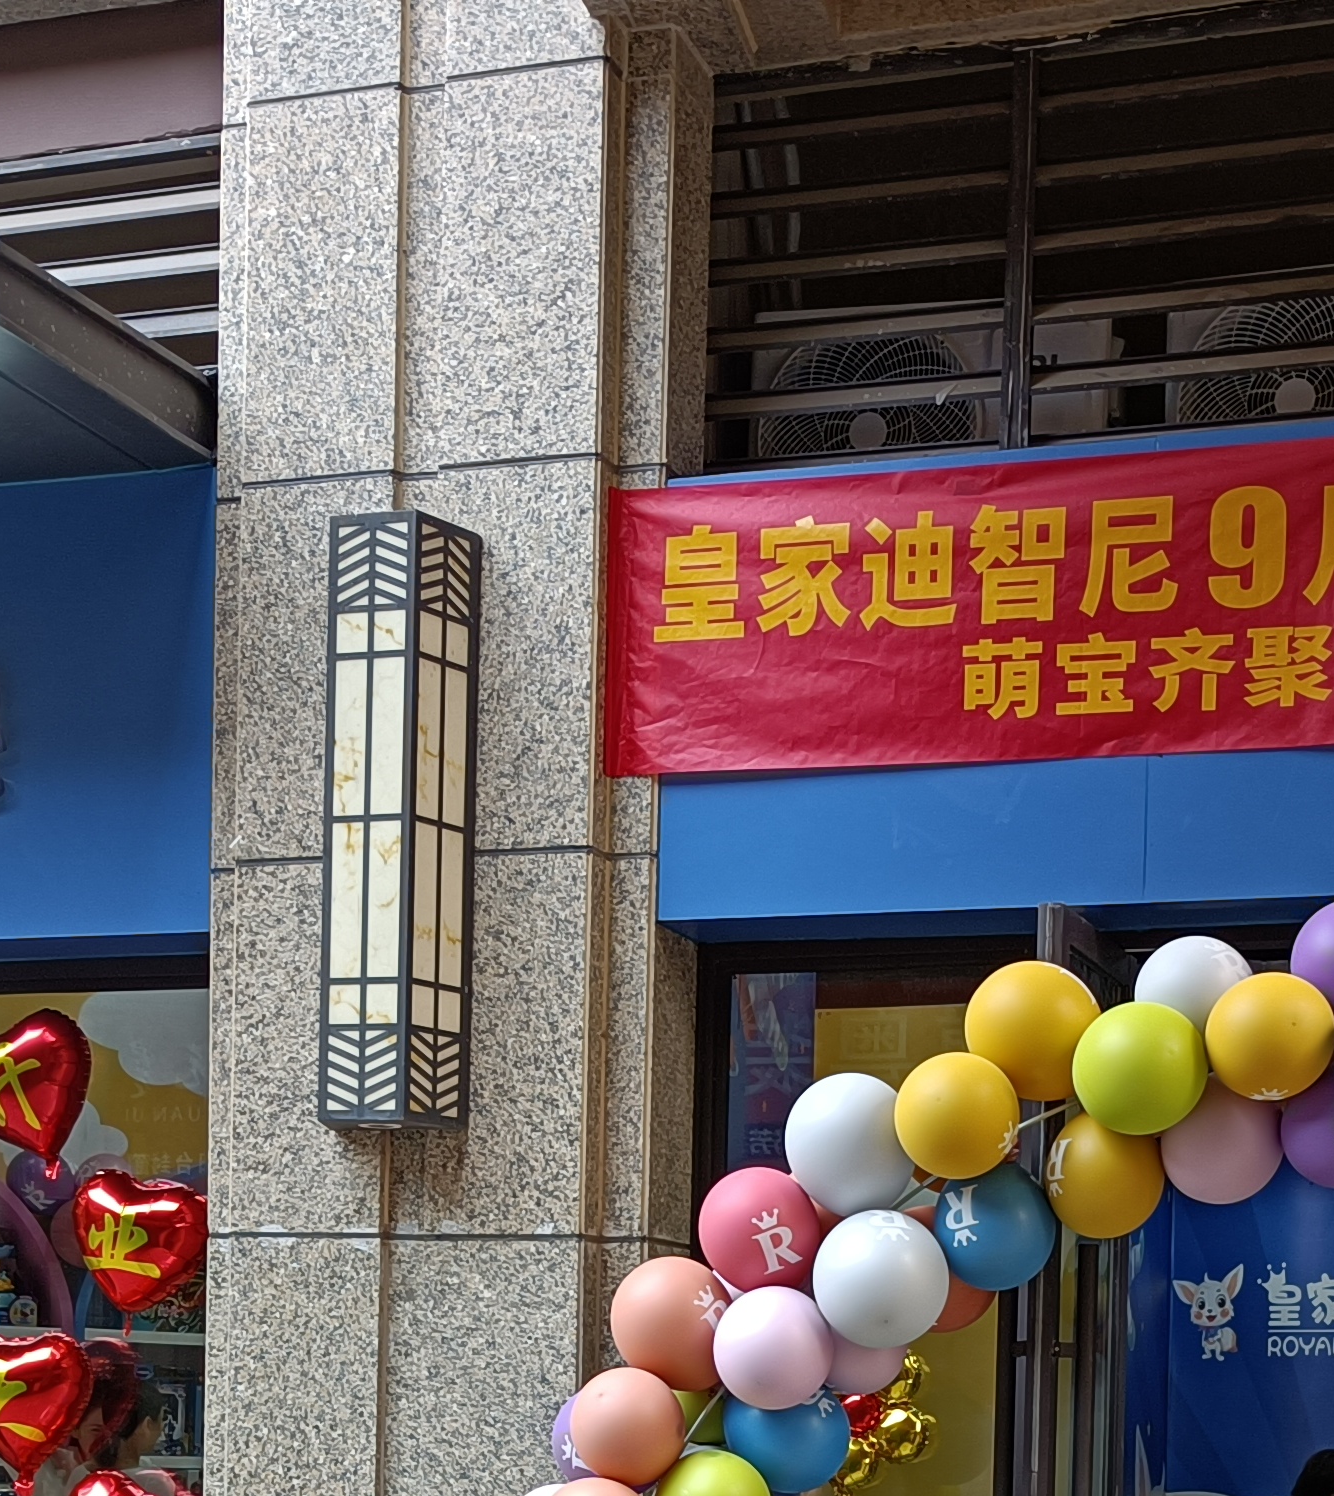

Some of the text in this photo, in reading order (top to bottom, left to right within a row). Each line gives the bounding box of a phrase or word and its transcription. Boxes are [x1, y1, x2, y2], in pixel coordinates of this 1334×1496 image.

[962, 626, 1334, 721] 萌宝齐聚
[751, 1225, 803, 1276] R
